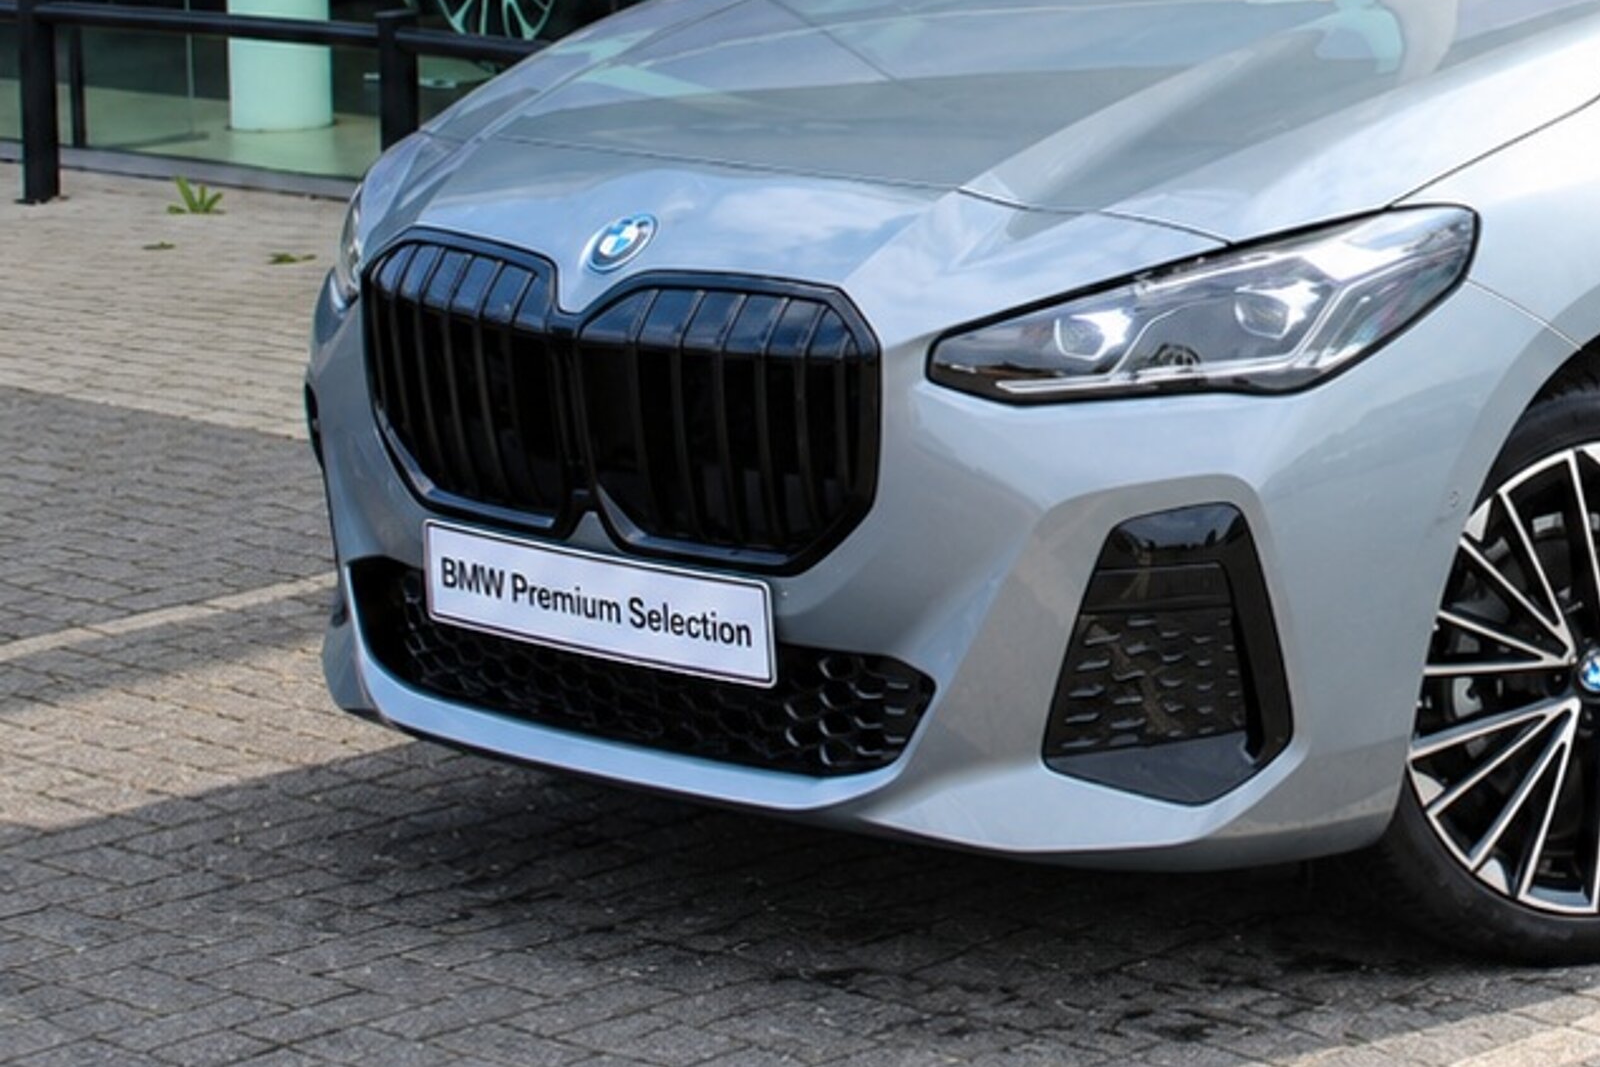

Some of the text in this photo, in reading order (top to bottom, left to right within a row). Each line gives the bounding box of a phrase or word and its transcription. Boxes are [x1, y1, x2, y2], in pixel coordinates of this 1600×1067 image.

[441, 557, 752, 648] BMW Premium Selection
